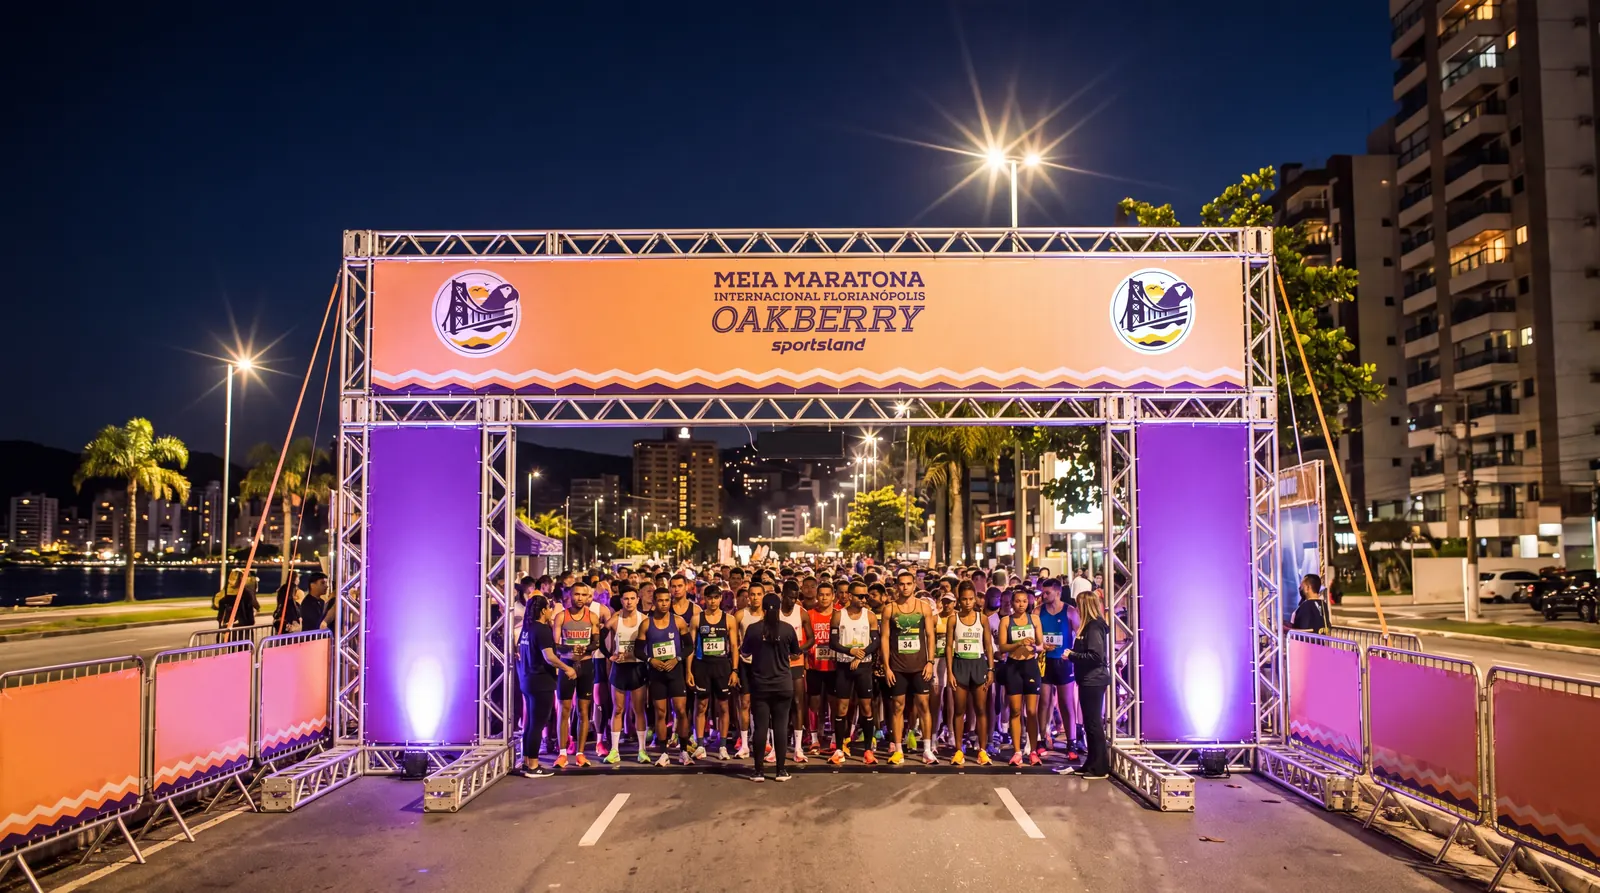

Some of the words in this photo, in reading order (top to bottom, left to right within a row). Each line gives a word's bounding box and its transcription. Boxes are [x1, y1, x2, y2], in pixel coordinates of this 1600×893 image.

[714, 271, 778, 288] MEIA
[784, 271, 925, 288] MARATONA
[714, 292, 820, 301] INTERNACIONAL
[823, 290, 925, 301] FLORIANÓPOLIS
[711, 305, 925, 333] OAKBERRY
[771, 338, 866, 354] sportsland
